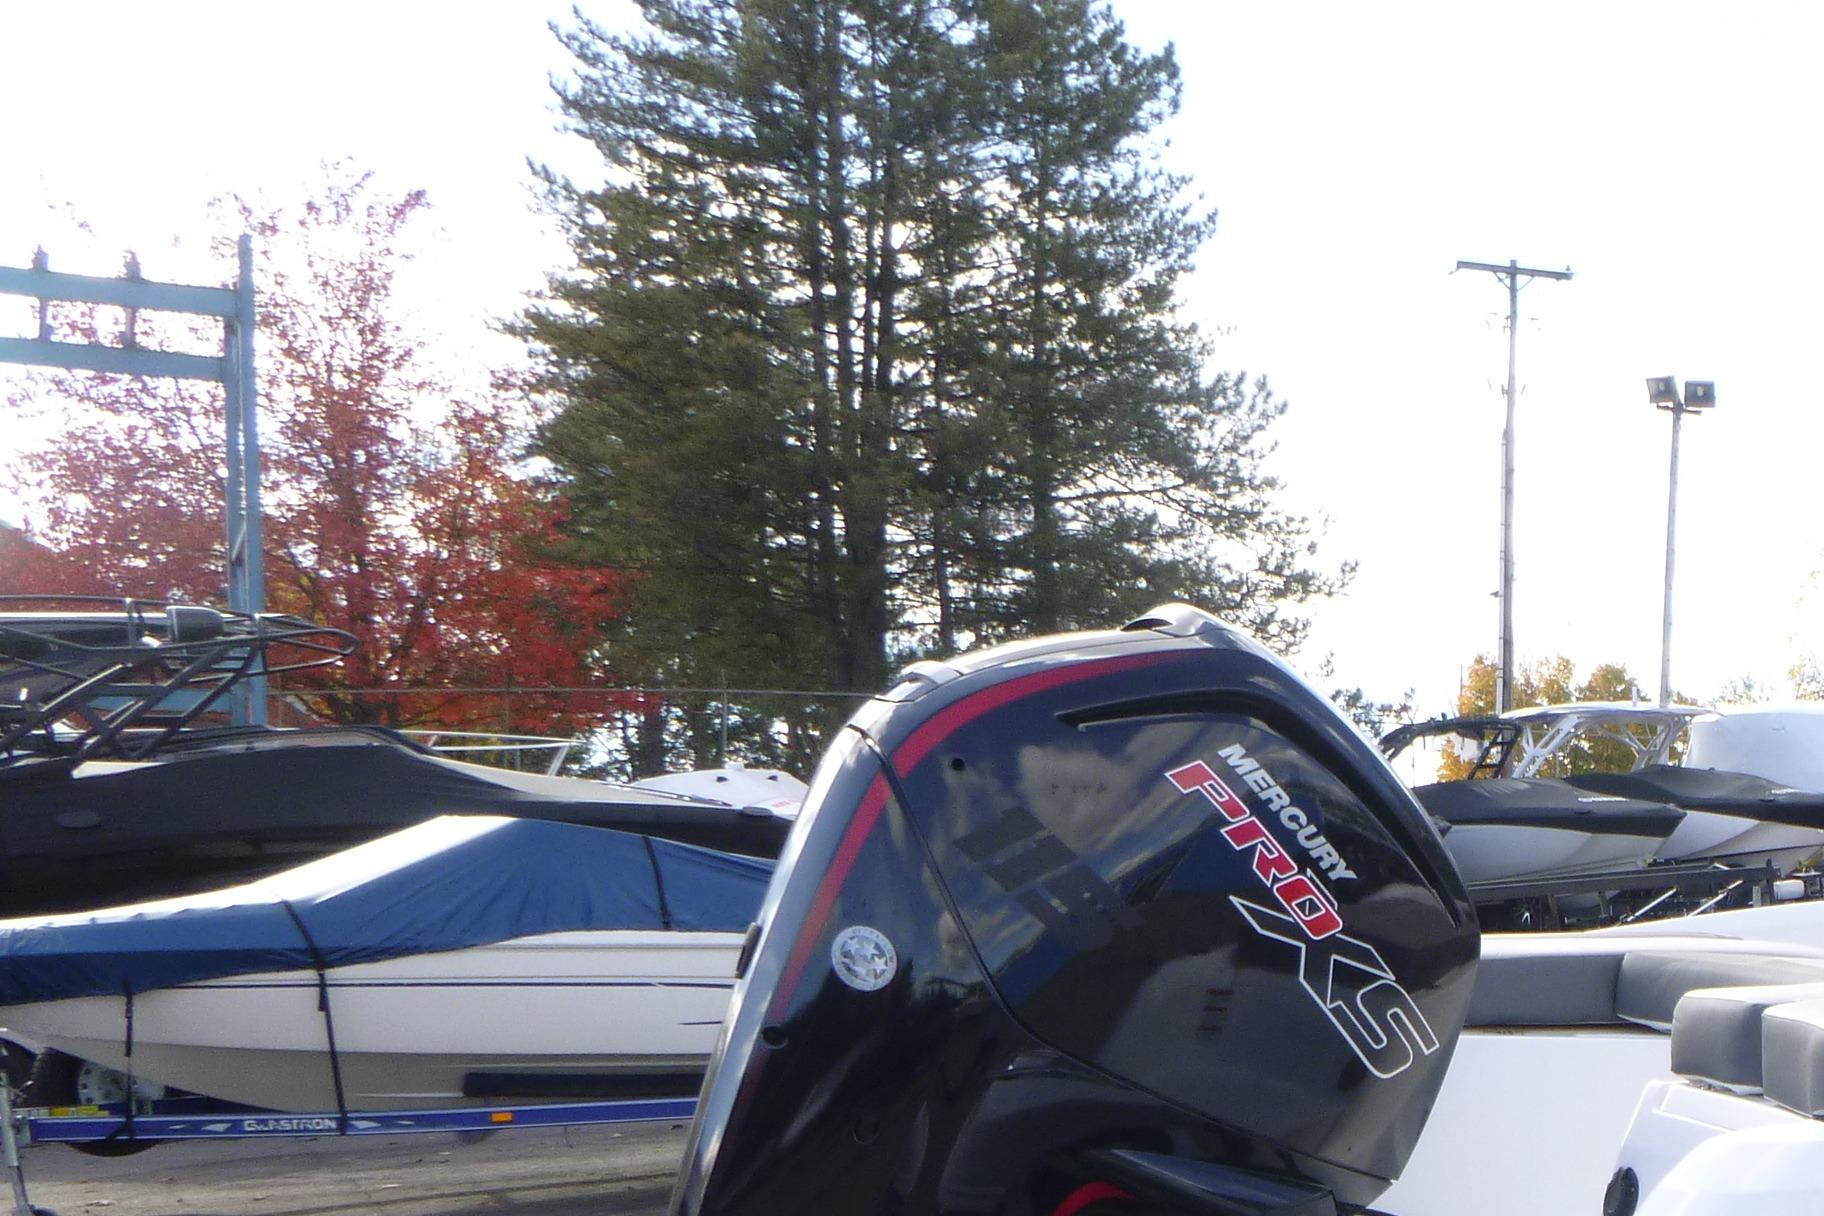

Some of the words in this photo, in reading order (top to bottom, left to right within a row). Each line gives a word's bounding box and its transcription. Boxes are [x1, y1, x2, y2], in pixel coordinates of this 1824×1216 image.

[1164, 760, 1343, 939] PRO
[1218, 744, 1358, 881] MERCURY
[1229, 868, 1440, 1078] XS
